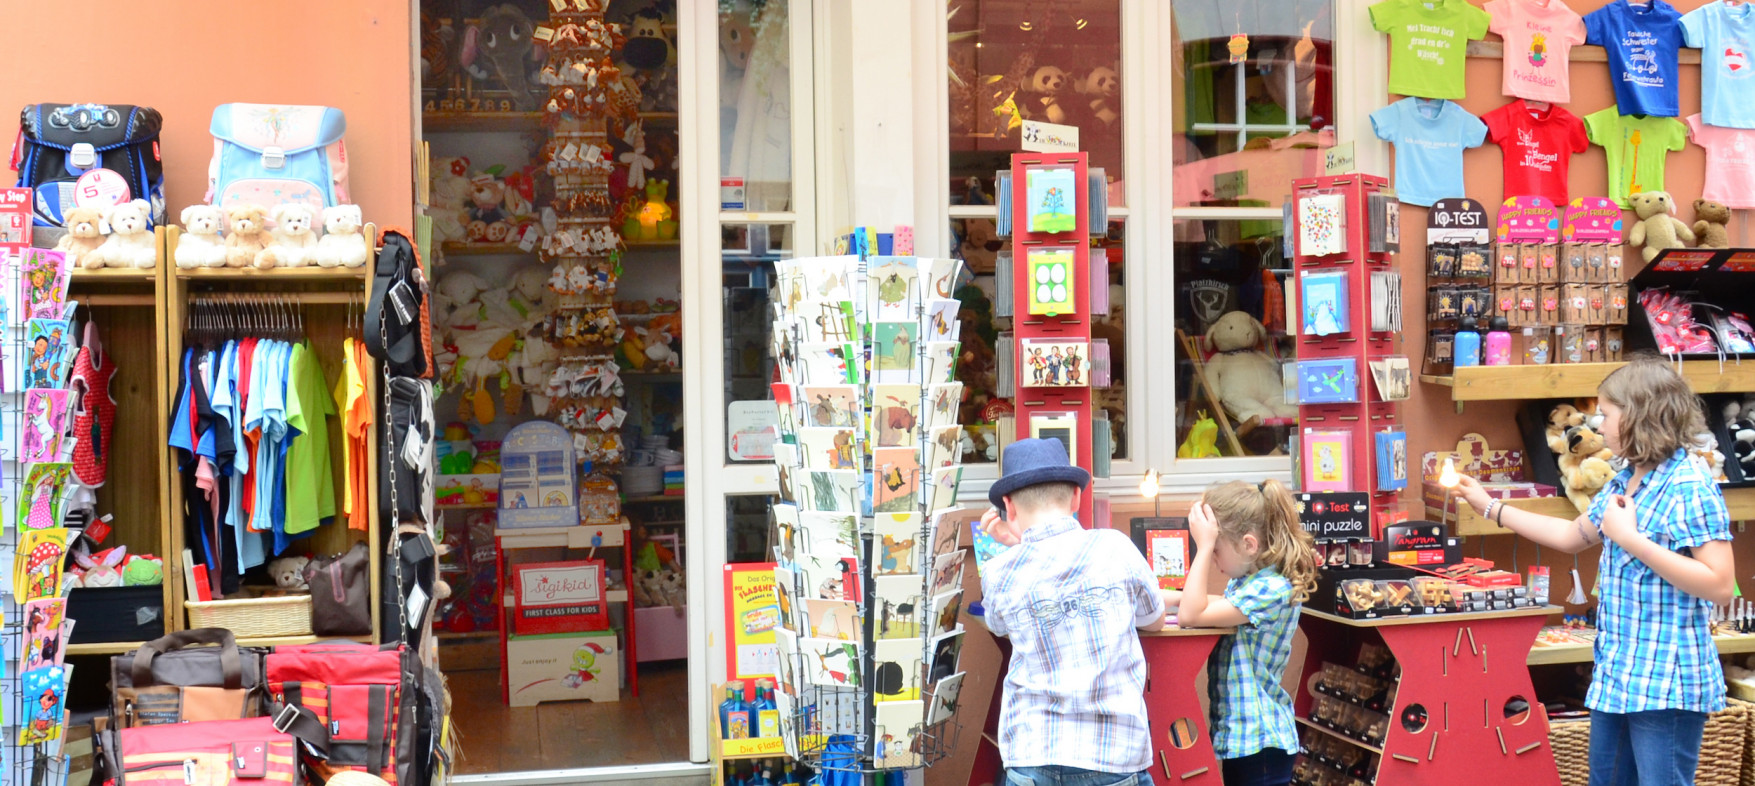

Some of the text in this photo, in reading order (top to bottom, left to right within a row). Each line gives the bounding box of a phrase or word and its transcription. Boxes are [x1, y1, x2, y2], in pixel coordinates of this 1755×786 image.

[1526, 21, 1552, 33] Kleine
[1622, 37, 1658, 46] Schwester
[1513, 69, 1557, 86] Prinzessin
[1532, 149, 1558, 164] Bengel
[6, 190, 26, 204] Step
[83, 185, 99, 198] 5
[1434, 211, 1482, 228] IQ-TEST
[1501, 208, 1553, 221] HAPPY FRIENDS
[1567, 209, 1618, 222] HAPPY FRIENDS
[1323, 517, 1363, 535] puzzle
[1393, 533, 1437, 549] Tangram
[747, 575, 776, 584] Das Orig
[530, 577, 592, 599] sigikid
[738, 584, 776, 600] FLASCHE
[525, 605, 597, 617] FIRST CLASS FOR KIDS
[1063, 599, 1078, 613] 26
[739, 739, 784, 754] Die Flasch
